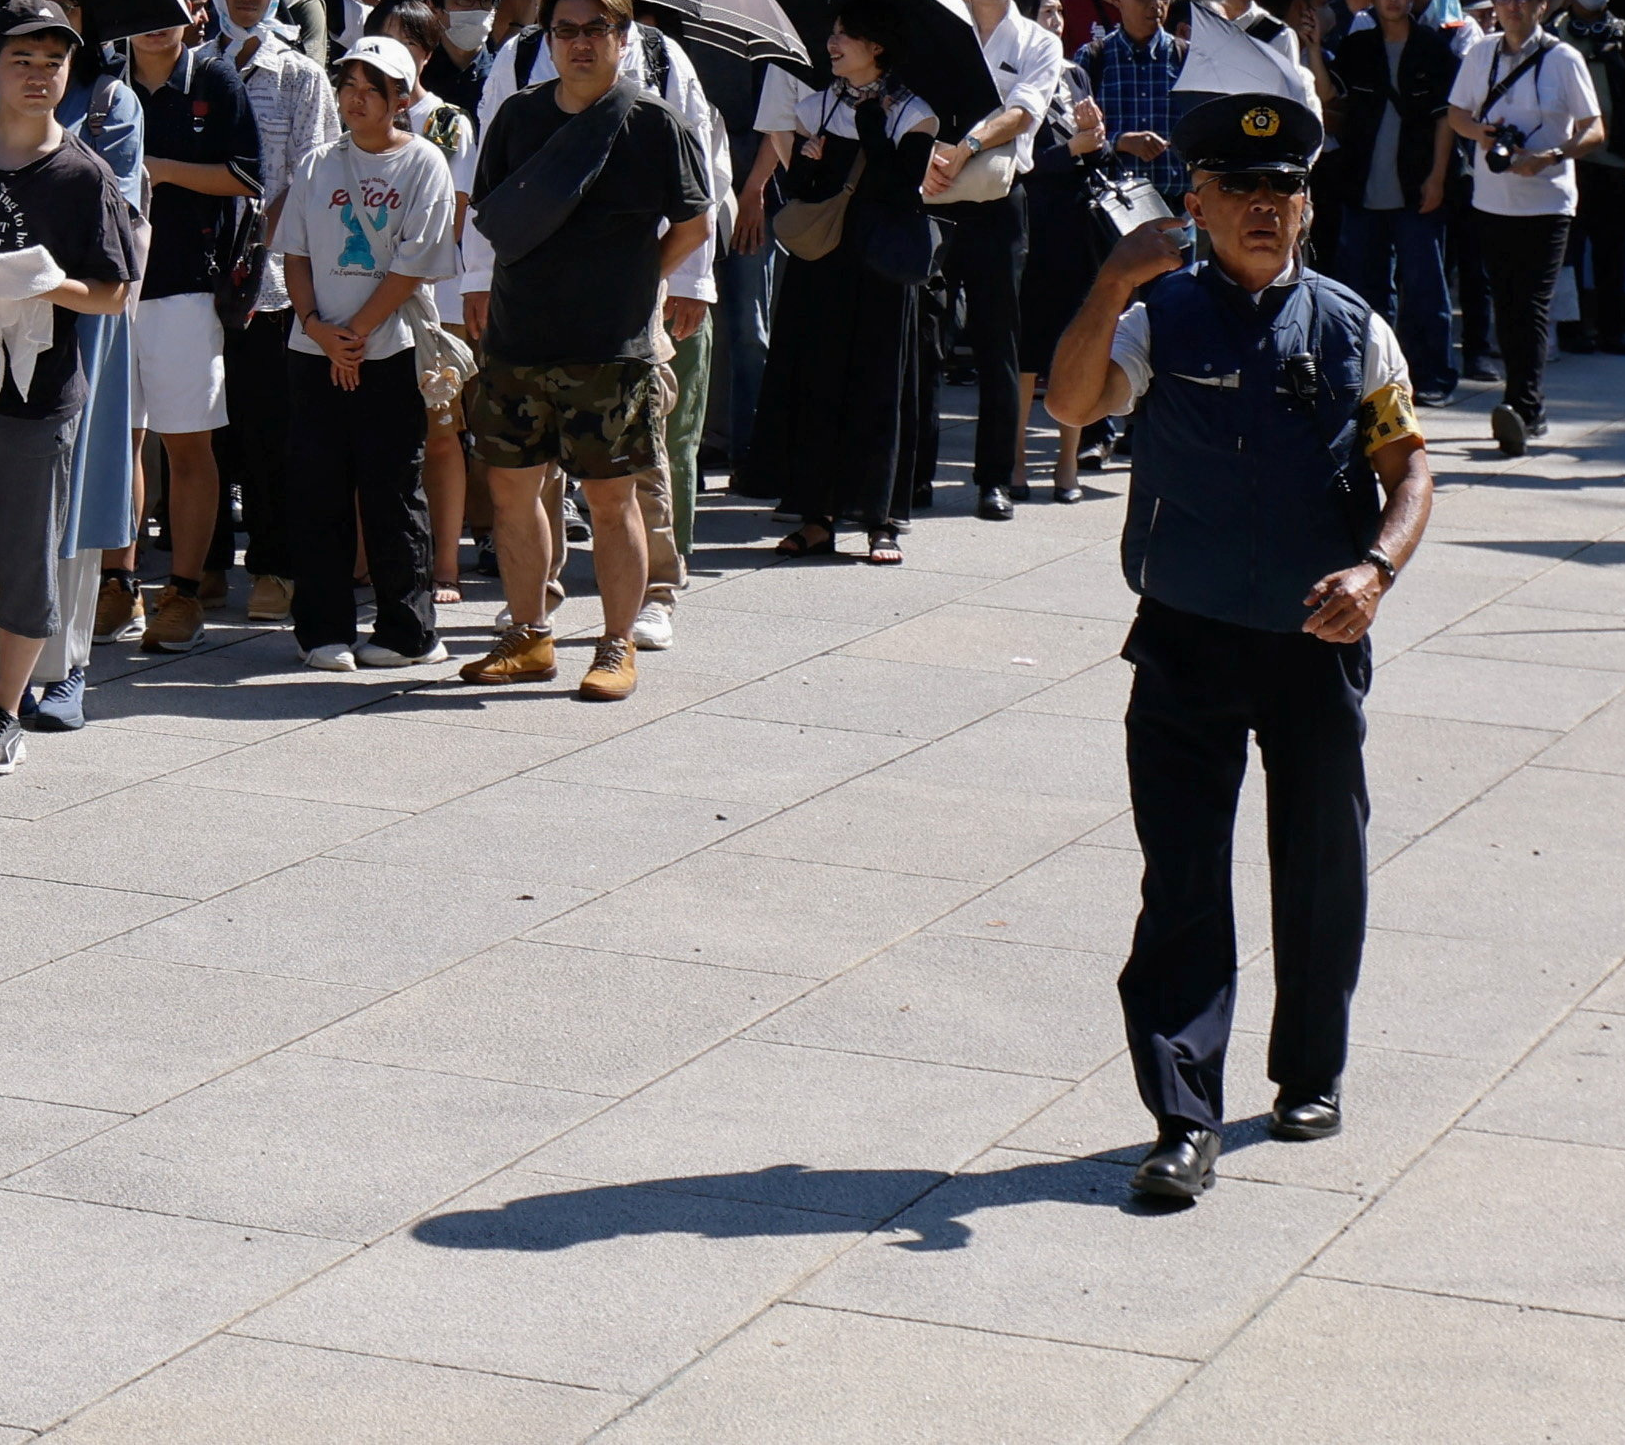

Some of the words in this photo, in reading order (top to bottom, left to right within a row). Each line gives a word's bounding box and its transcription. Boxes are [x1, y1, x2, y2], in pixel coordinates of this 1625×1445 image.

[328, 187, 402, 210] Sitch
[13, 212, 25, 228] to
[15, 231, 29, 248] be
